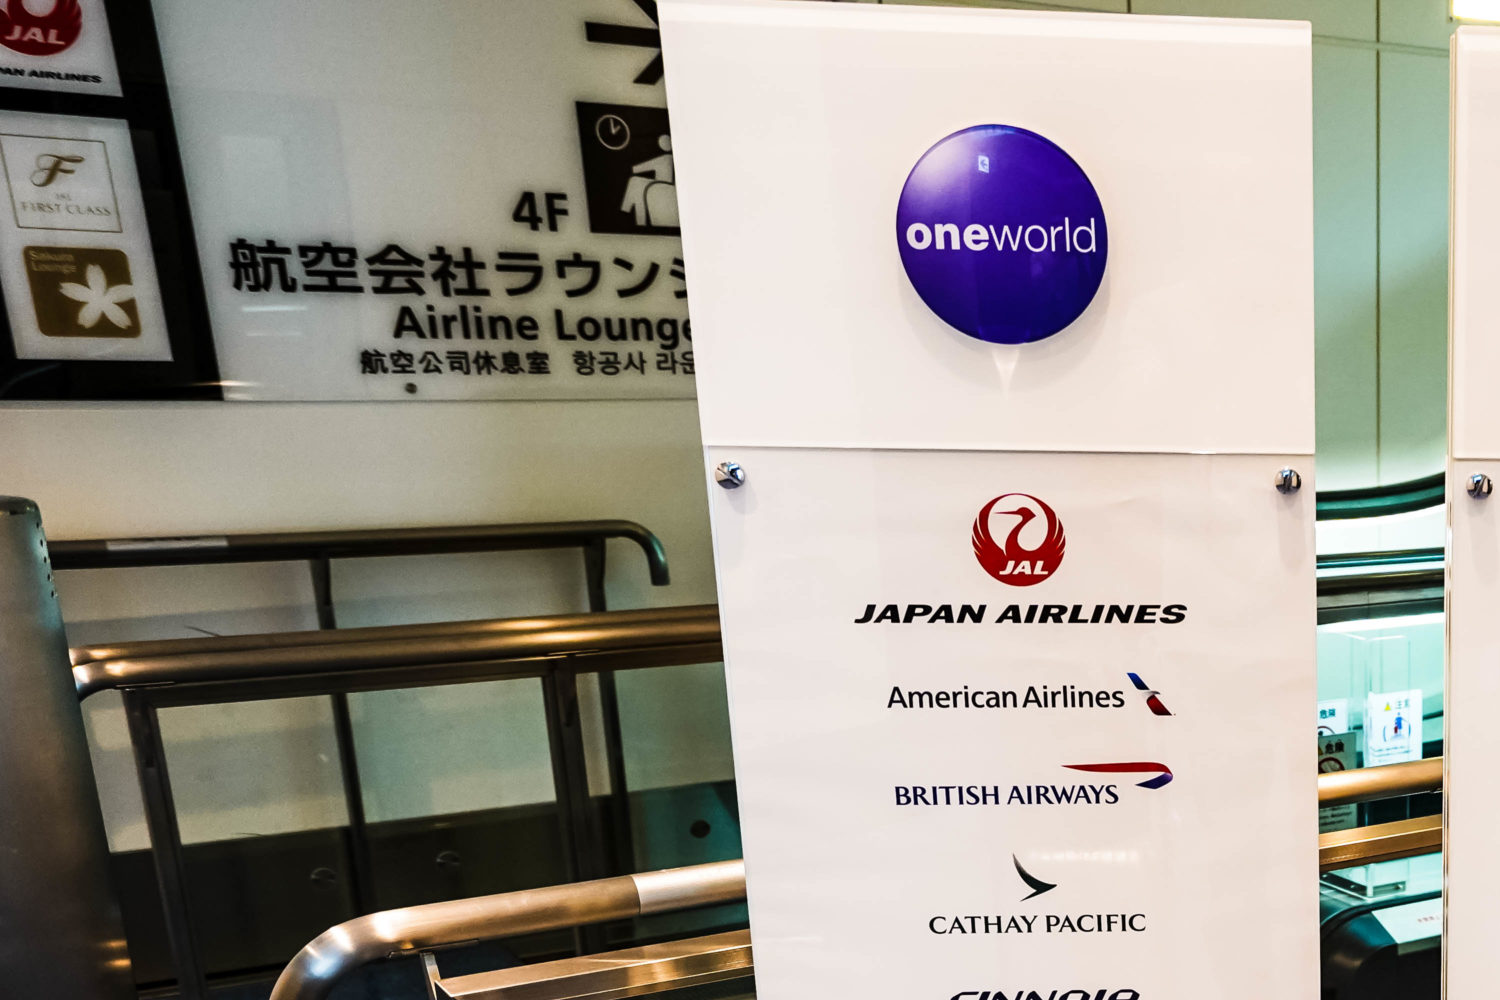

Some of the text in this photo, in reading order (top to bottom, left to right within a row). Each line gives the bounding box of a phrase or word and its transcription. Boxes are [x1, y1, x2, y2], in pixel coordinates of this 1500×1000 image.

[4, 25, 66, 46] JAL
[28, 69, 103, 83] AIRLINES
[21, 201, 112, 217] FIRST CLASS
[511, 190, 570, 233] 4F
[905, 216, 1097, 254] oneworld
[393, 303, 540, 341] Airline
[360, 350, 552, 376] 航空公司休息室
[571, 350, 648, 376] 항공사
[998, 559, 1049, 576] JAL
[854, 603, 1188, 625] JAPAN AIRLINES
[886, 684, 1126, 709] American Airlines
[894, 784, 1120, 807] BRITISH AIRWAYS
[928, 913, 1147, 935] CATHAY PACIFIC
